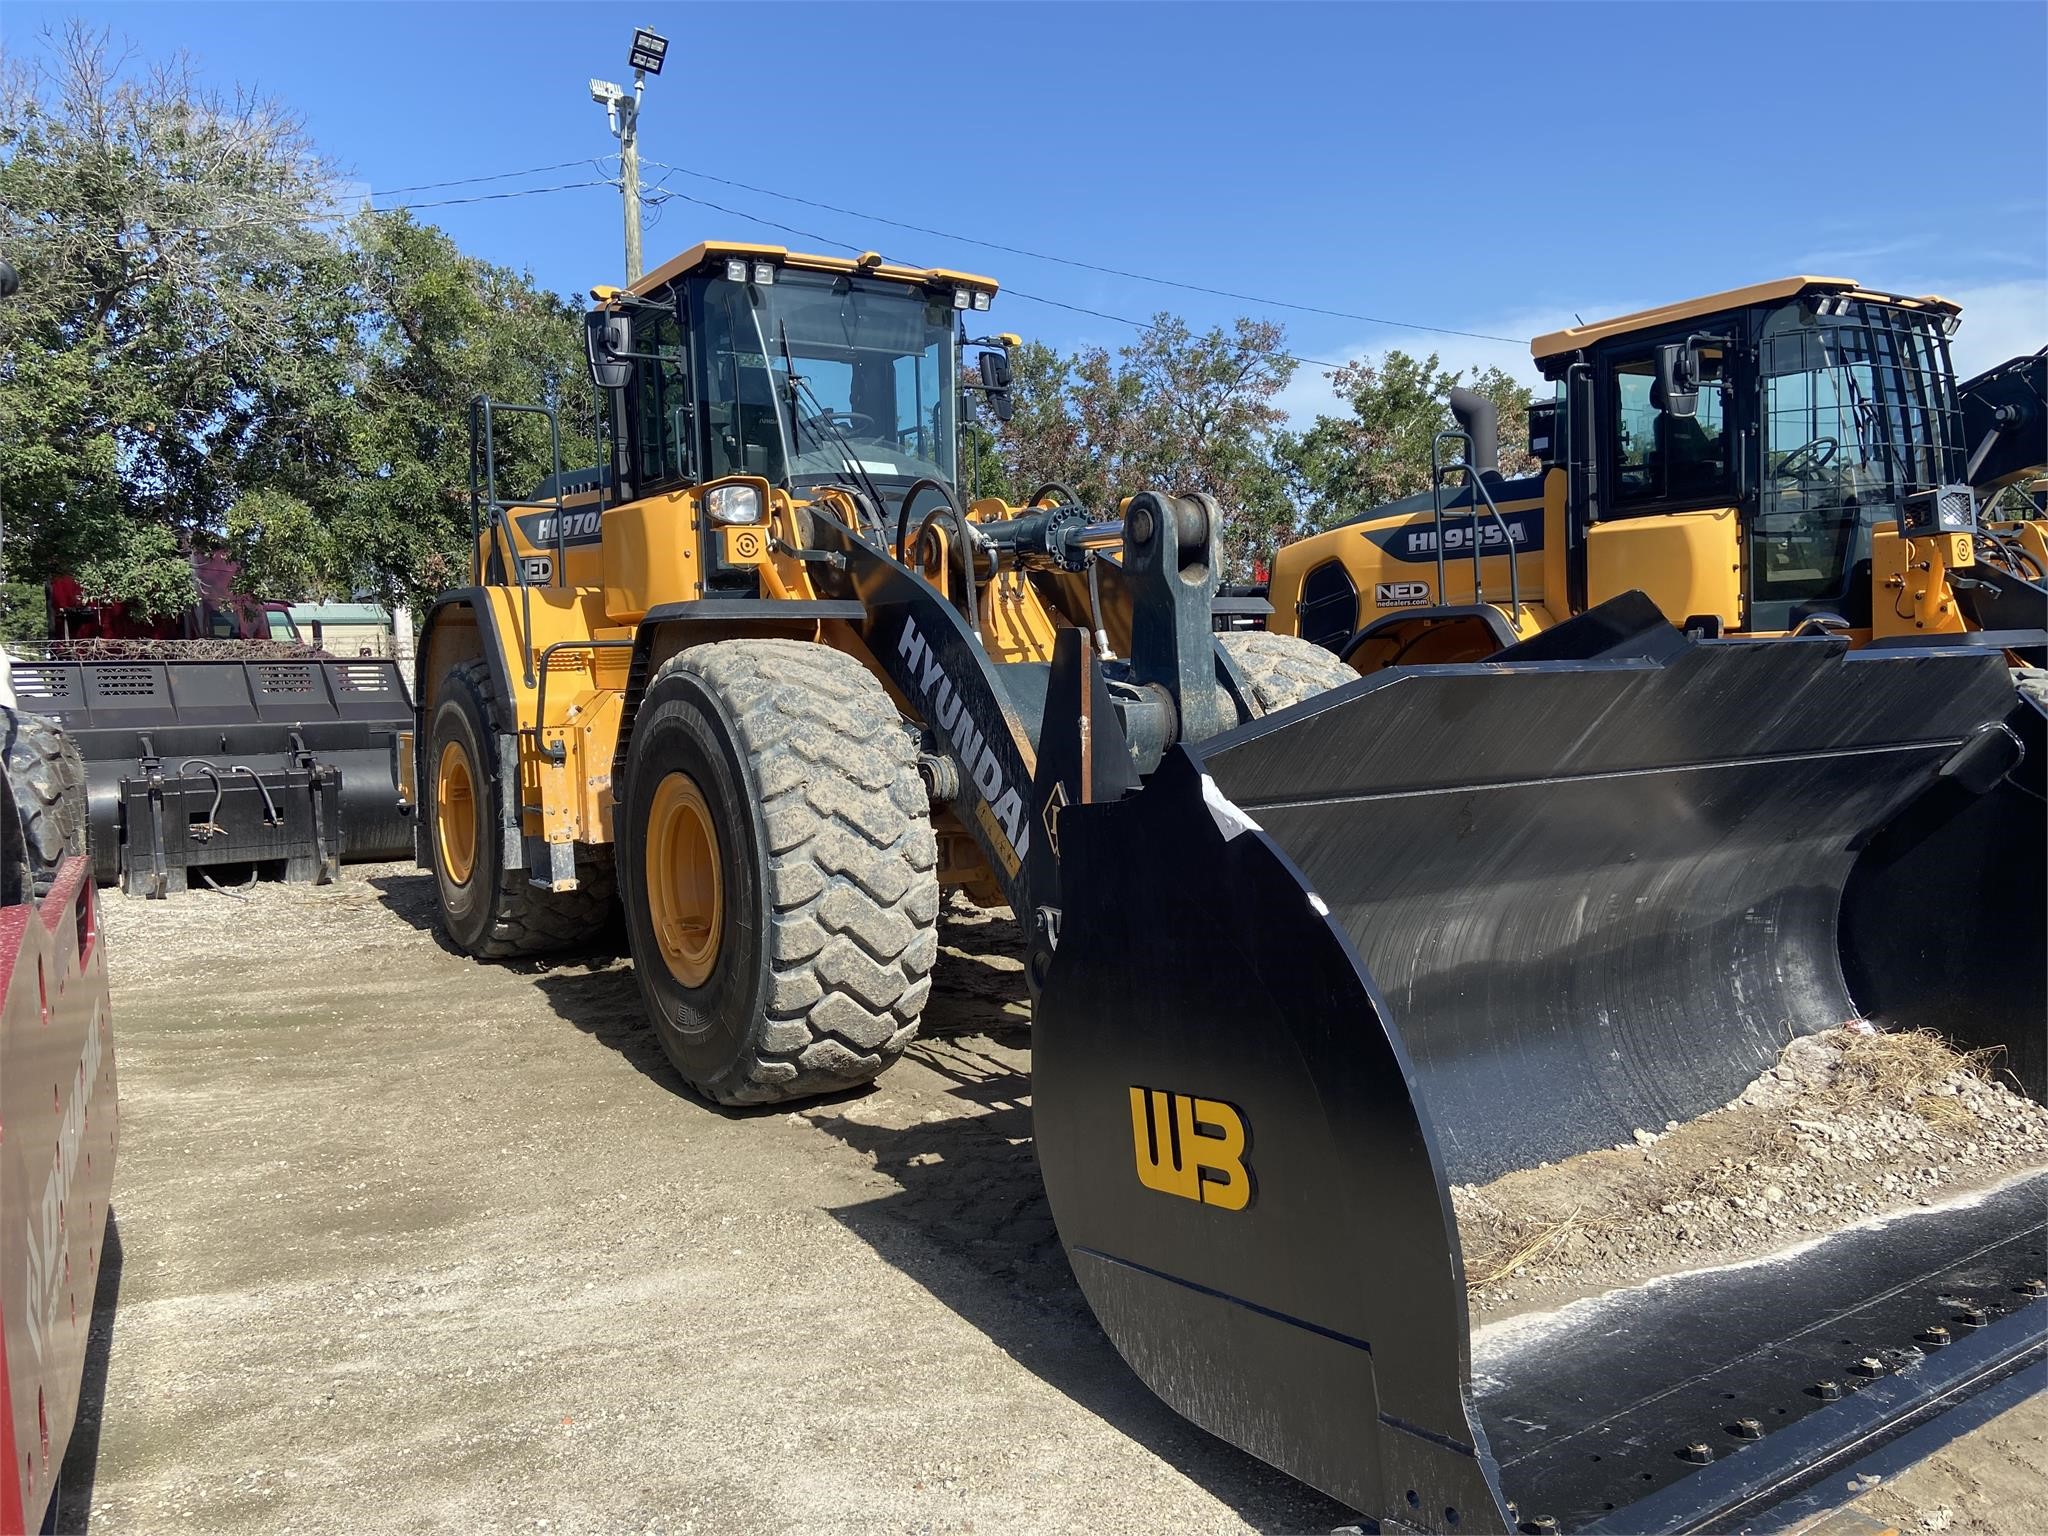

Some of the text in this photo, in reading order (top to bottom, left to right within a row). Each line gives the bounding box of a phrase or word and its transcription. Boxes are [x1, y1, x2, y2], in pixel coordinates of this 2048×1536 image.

[1376, 583, 1428, 600] NED
[1377, 599, 1428, 607] nedealers.com
[897, 615, 1030, 862] HYUNDAI
